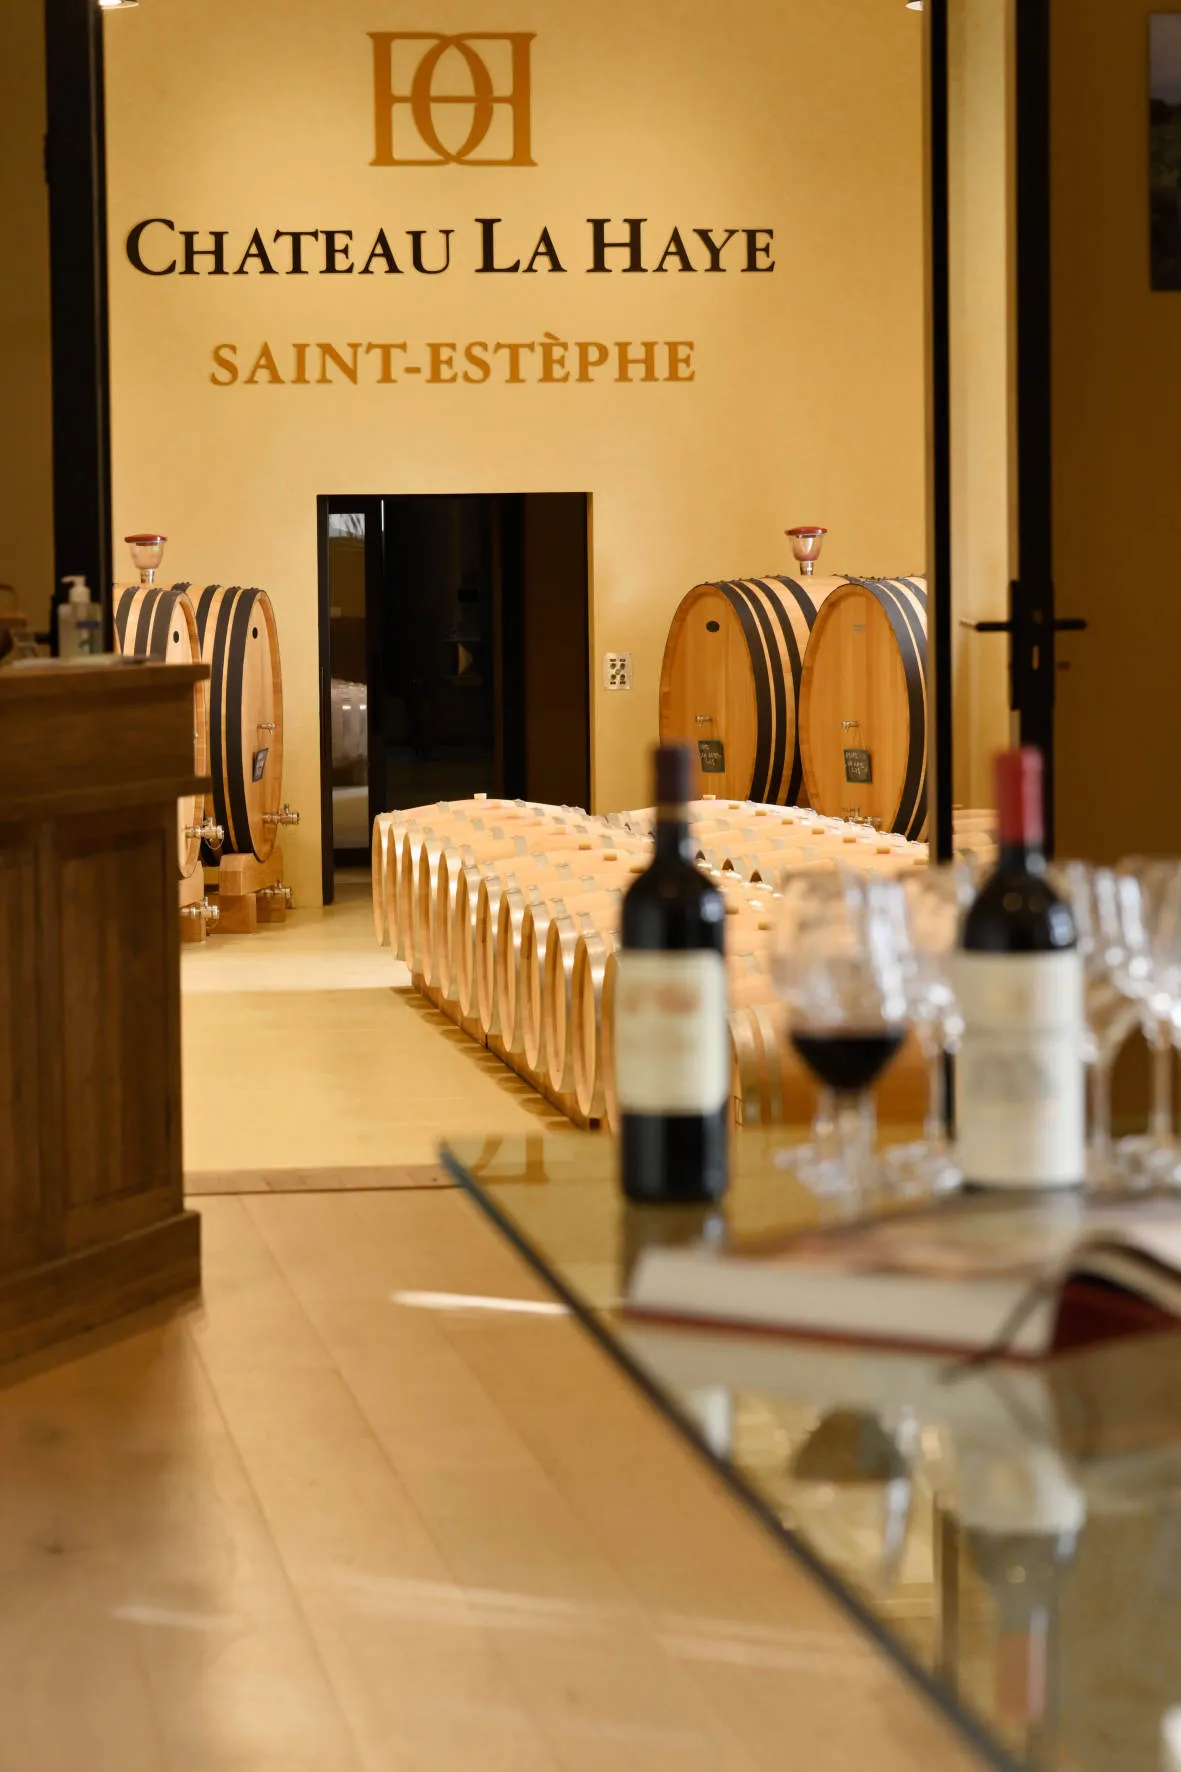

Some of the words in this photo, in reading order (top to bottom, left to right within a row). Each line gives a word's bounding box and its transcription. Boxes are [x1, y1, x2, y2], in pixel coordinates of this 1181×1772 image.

[125, 217, 456, 277] CHATEAU
[473, 217, 568, 275] LA
[585, 217, 776, 275] HAYE
[209, 331, 696, 387] SAINT-ESTÈPHE
